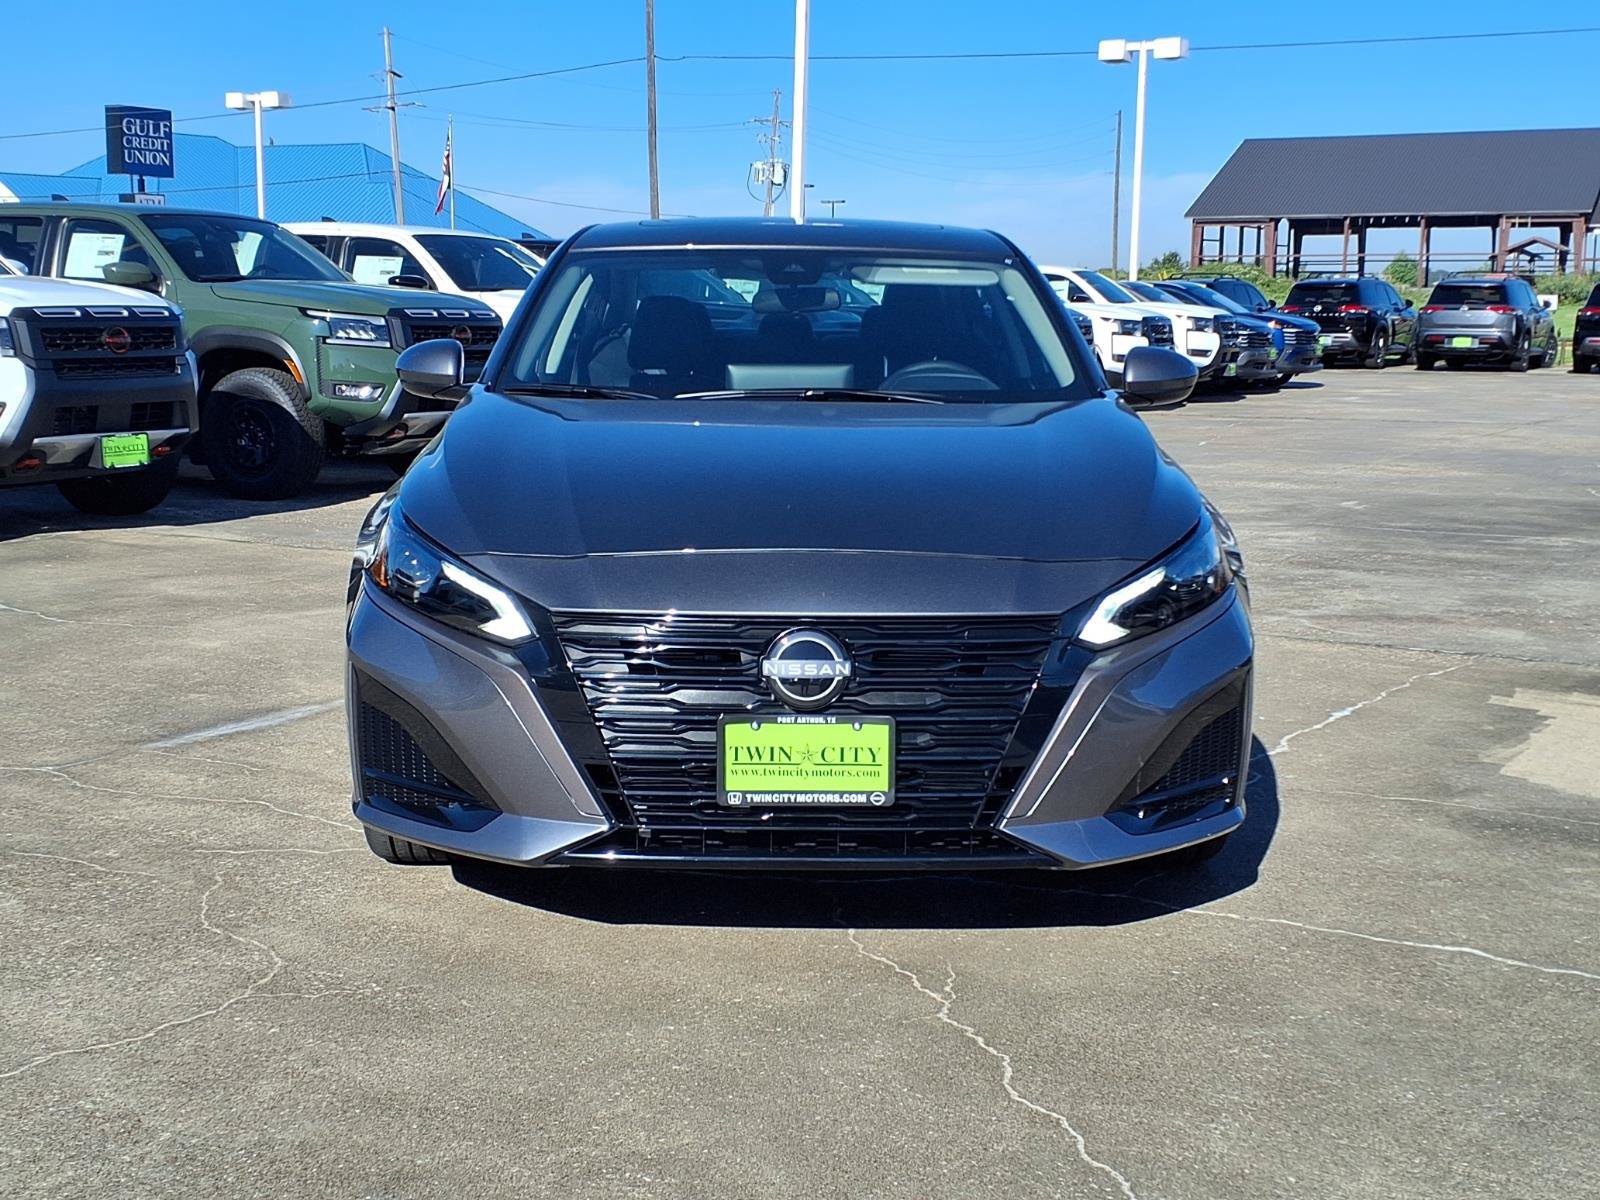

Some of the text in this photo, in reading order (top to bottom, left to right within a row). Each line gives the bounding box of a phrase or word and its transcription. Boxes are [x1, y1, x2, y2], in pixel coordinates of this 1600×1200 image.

[122, 117, 170, 137] GULF
[122, 135, 170, 151] CREDIT
[124, 149, 170, 166] UNION
[765, 663, 850, 676] NISSAN
[777, 716, 796, 724] PORT
[730, 746, 881, 763] TWIN CITY
[731, 767, 880, 779] www.twincitymotors.com
[745, 793, 867, 803] TWINCITYMOTORS.COM
